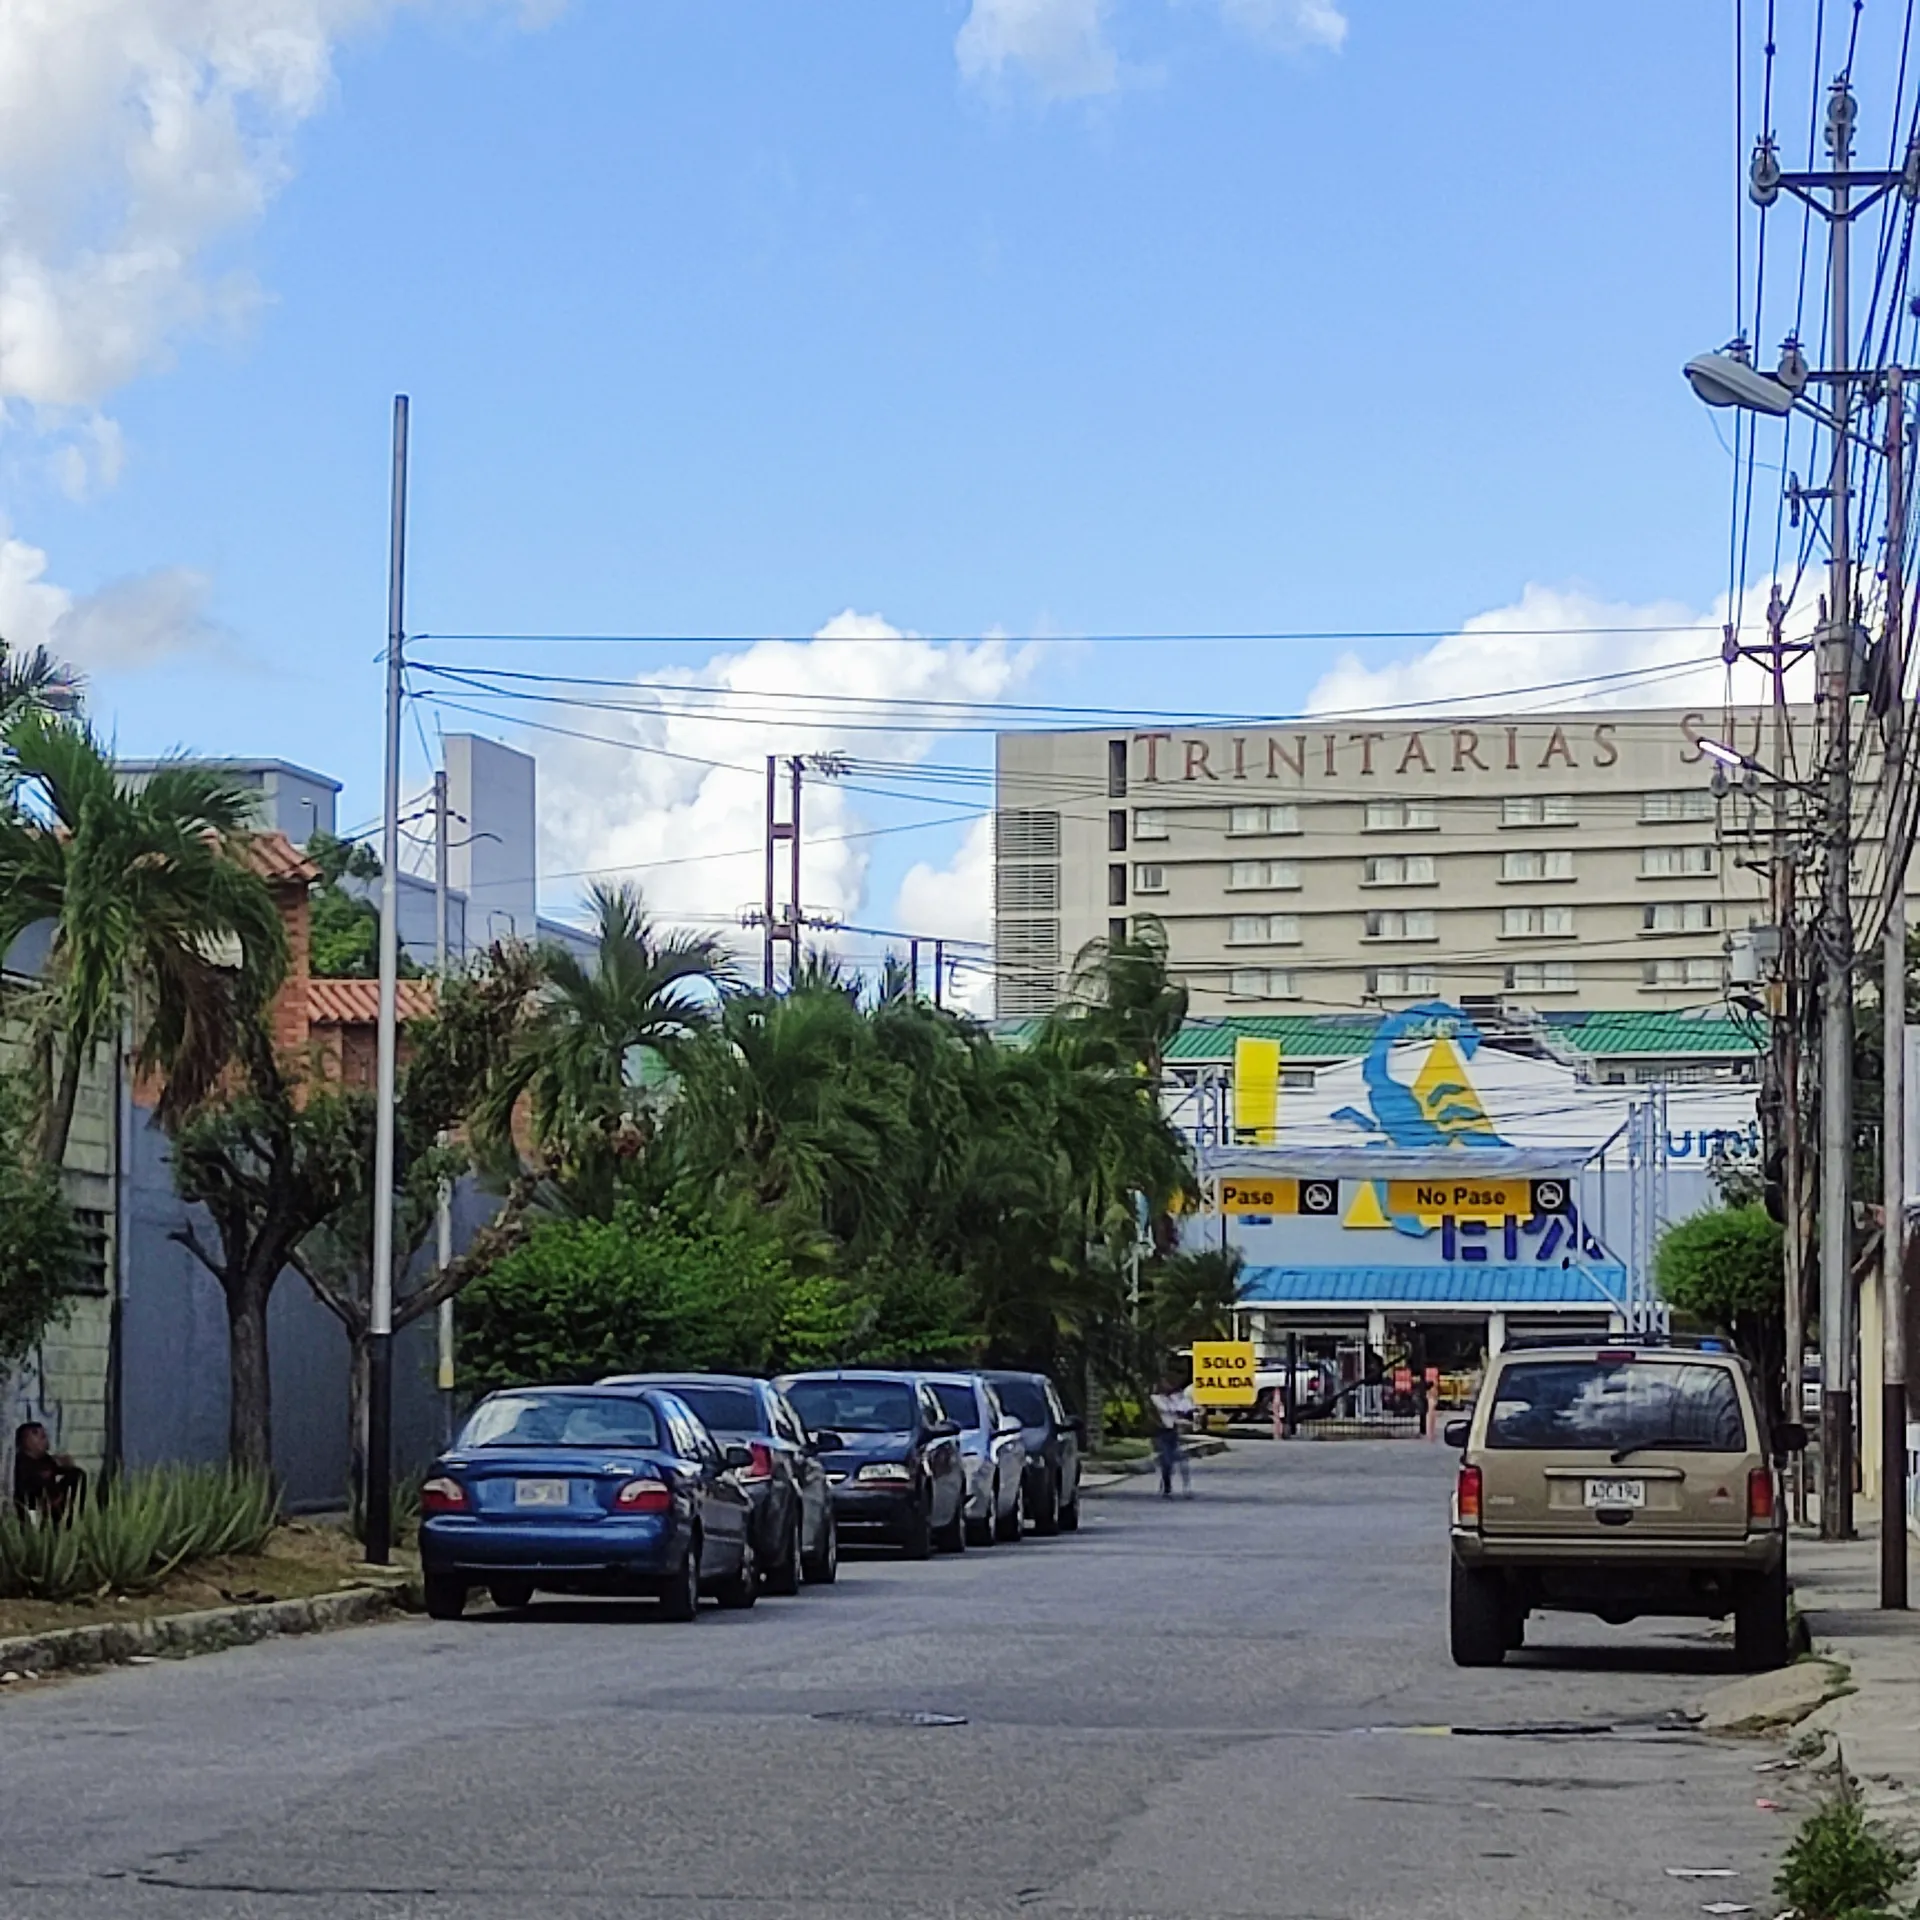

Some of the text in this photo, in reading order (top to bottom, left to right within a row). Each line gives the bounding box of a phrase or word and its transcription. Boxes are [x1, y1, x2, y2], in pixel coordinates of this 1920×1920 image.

[1133, 724, 1619, 782] TRINITARIAS
[1223, 1186, 1275, 1206] Pase
[1416, 1186, 1506, 1206] No Pase
[1202, 1356, 1247, 1370] SOLO
[1195, 1376, 1254, 1389] SALIDA
